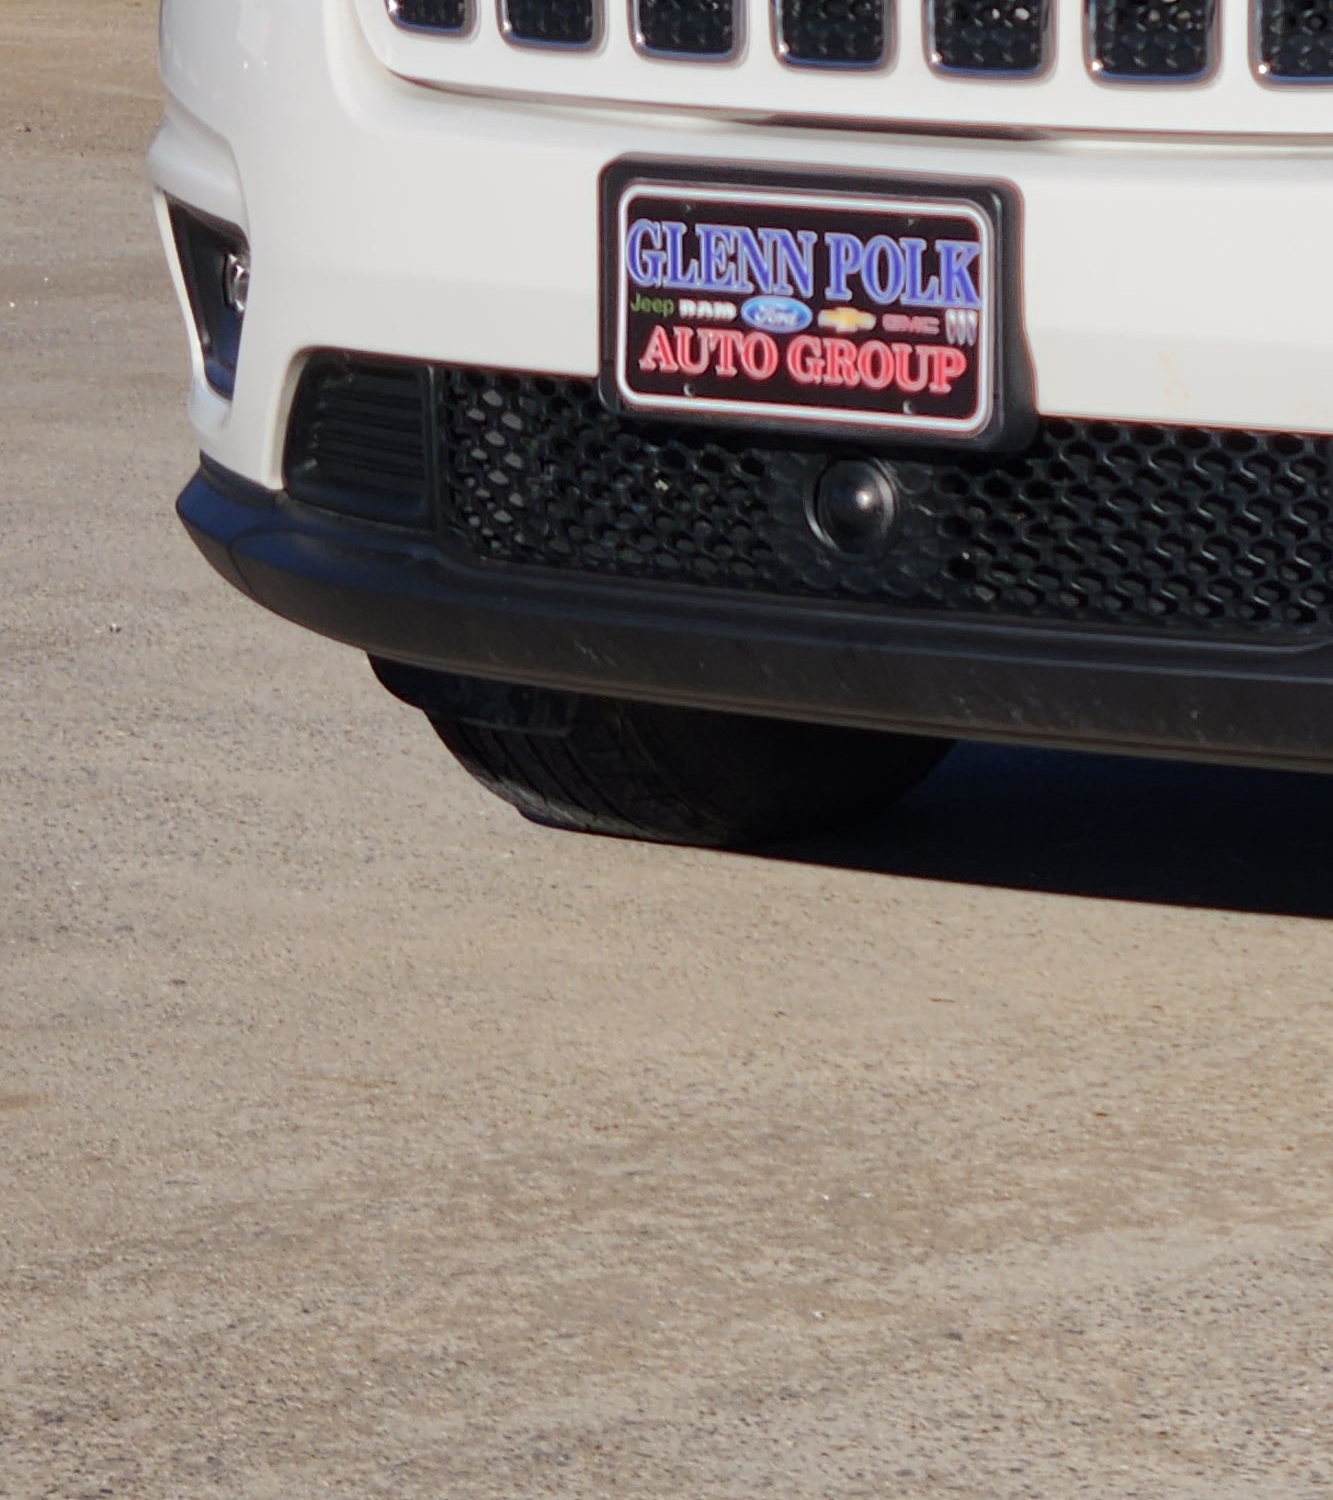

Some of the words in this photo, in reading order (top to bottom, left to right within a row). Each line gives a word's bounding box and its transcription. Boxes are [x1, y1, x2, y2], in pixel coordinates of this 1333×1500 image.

[626, 218, 818, 299] GLENN
[824, 232, 982, 308] POLK
[630, 293, 675, 318] Jeep
[678, 298, 738, 321] RAM
[752, 305, 800, 327] Ford
[882, 313, 941, 336] GMC
[638, 324, 779, 381] AUTO
[786, 333, 968, 394] GROUP
